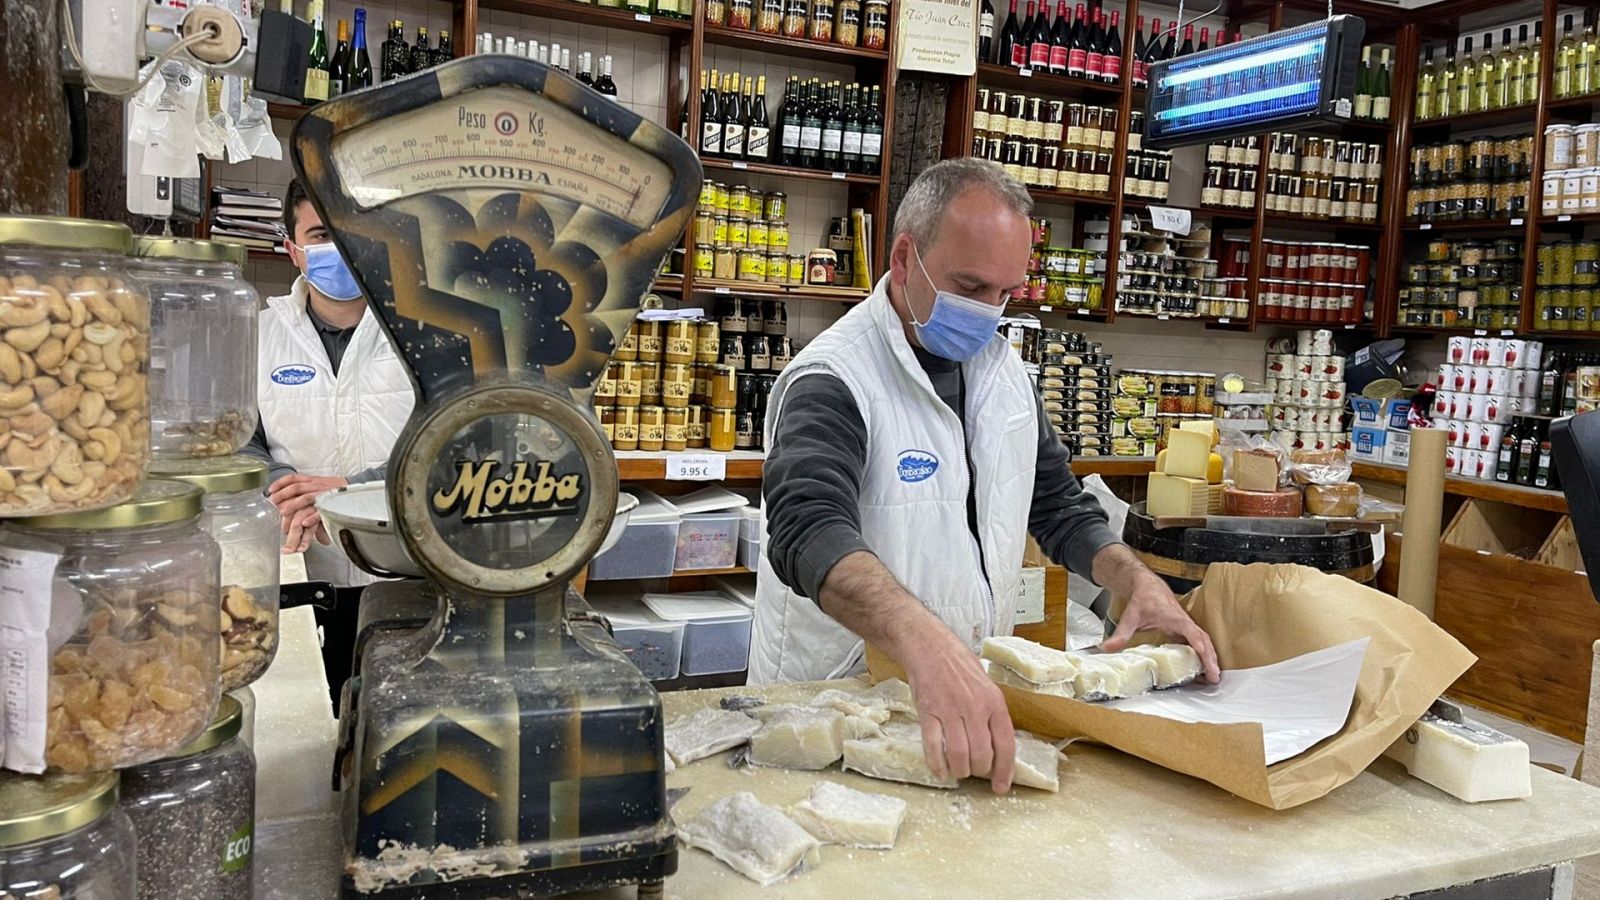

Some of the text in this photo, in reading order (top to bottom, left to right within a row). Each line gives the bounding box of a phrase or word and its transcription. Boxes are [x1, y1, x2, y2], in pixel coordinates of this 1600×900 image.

[458, 106, 486, 129] Peso
[434, 135, 448, 144] 700
[411, 164, 589, 194] BADALONA MOBBA ESPAÑA
[681, 467, 709, 476] 9.95 €
[433, 461, 581, 518] Mobba
[226, 835, 251, 862] ECO
